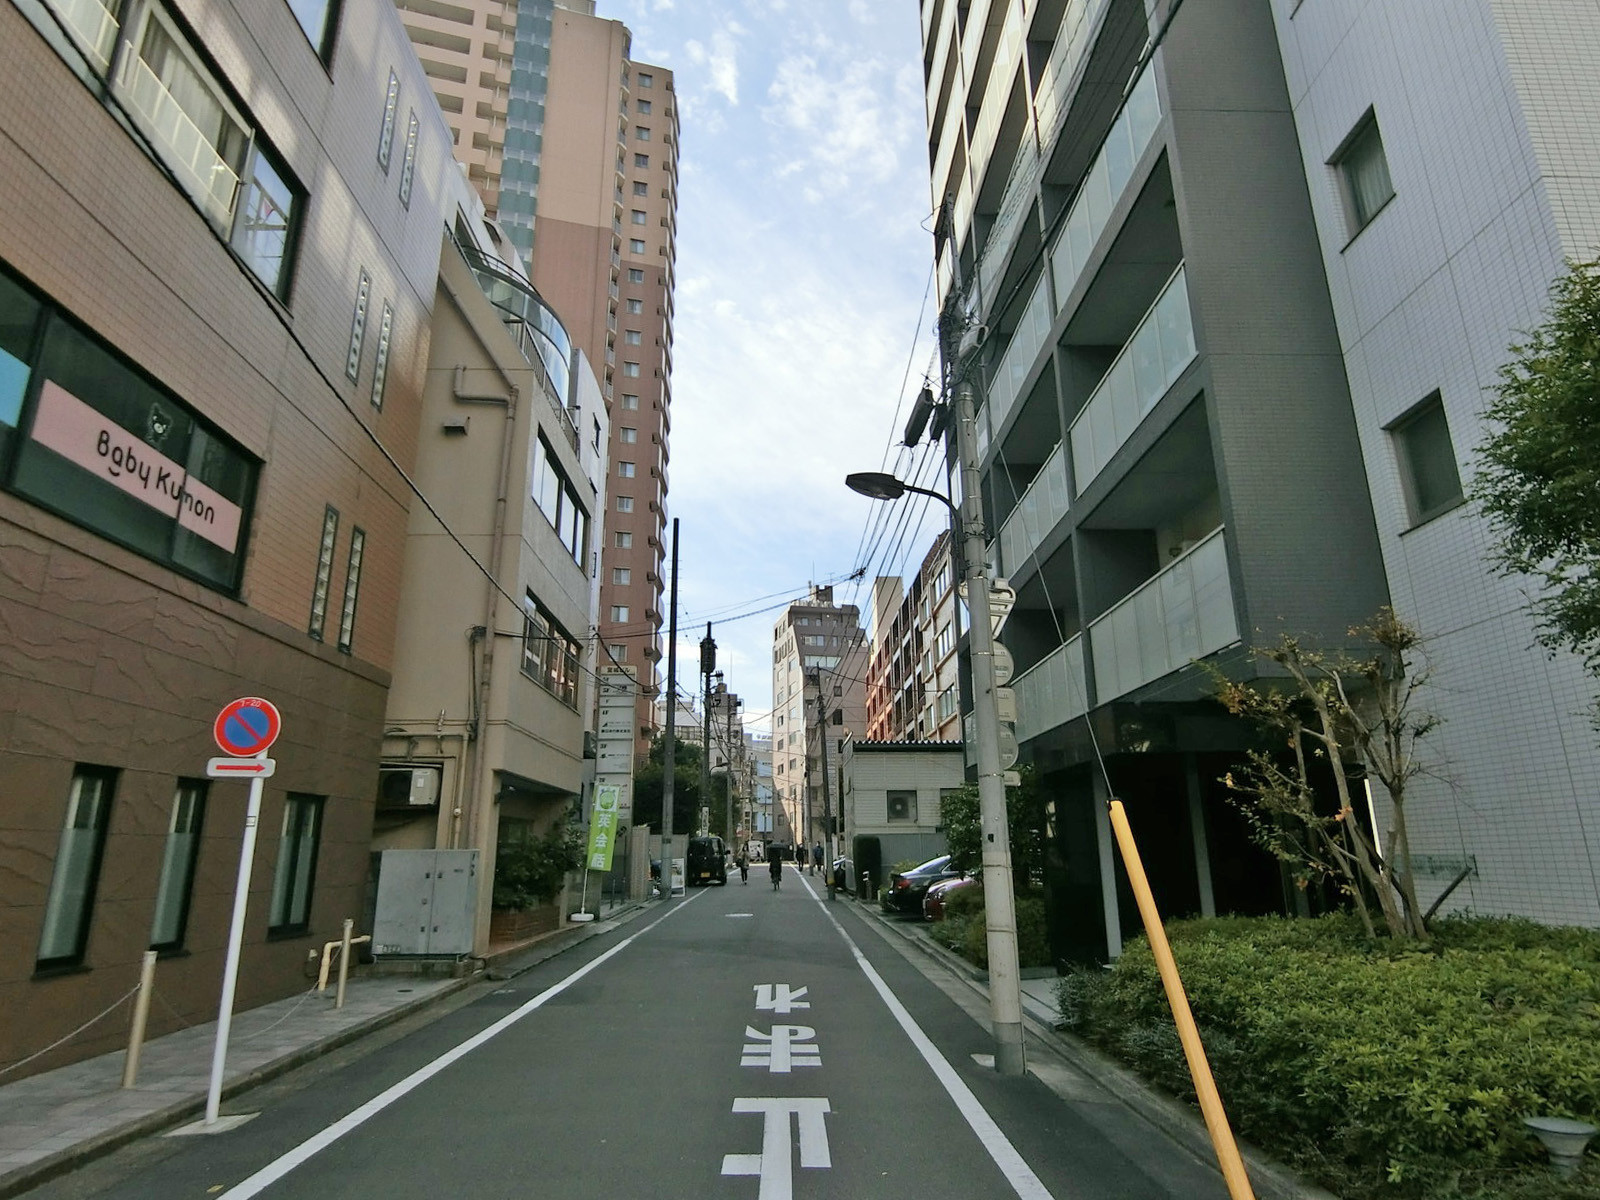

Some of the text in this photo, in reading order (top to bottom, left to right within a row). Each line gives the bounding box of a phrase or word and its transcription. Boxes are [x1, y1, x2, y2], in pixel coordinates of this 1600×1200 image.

[97, 430, 215, 525] Baby Kumon
[591, 813, 611, 868] 英会話
